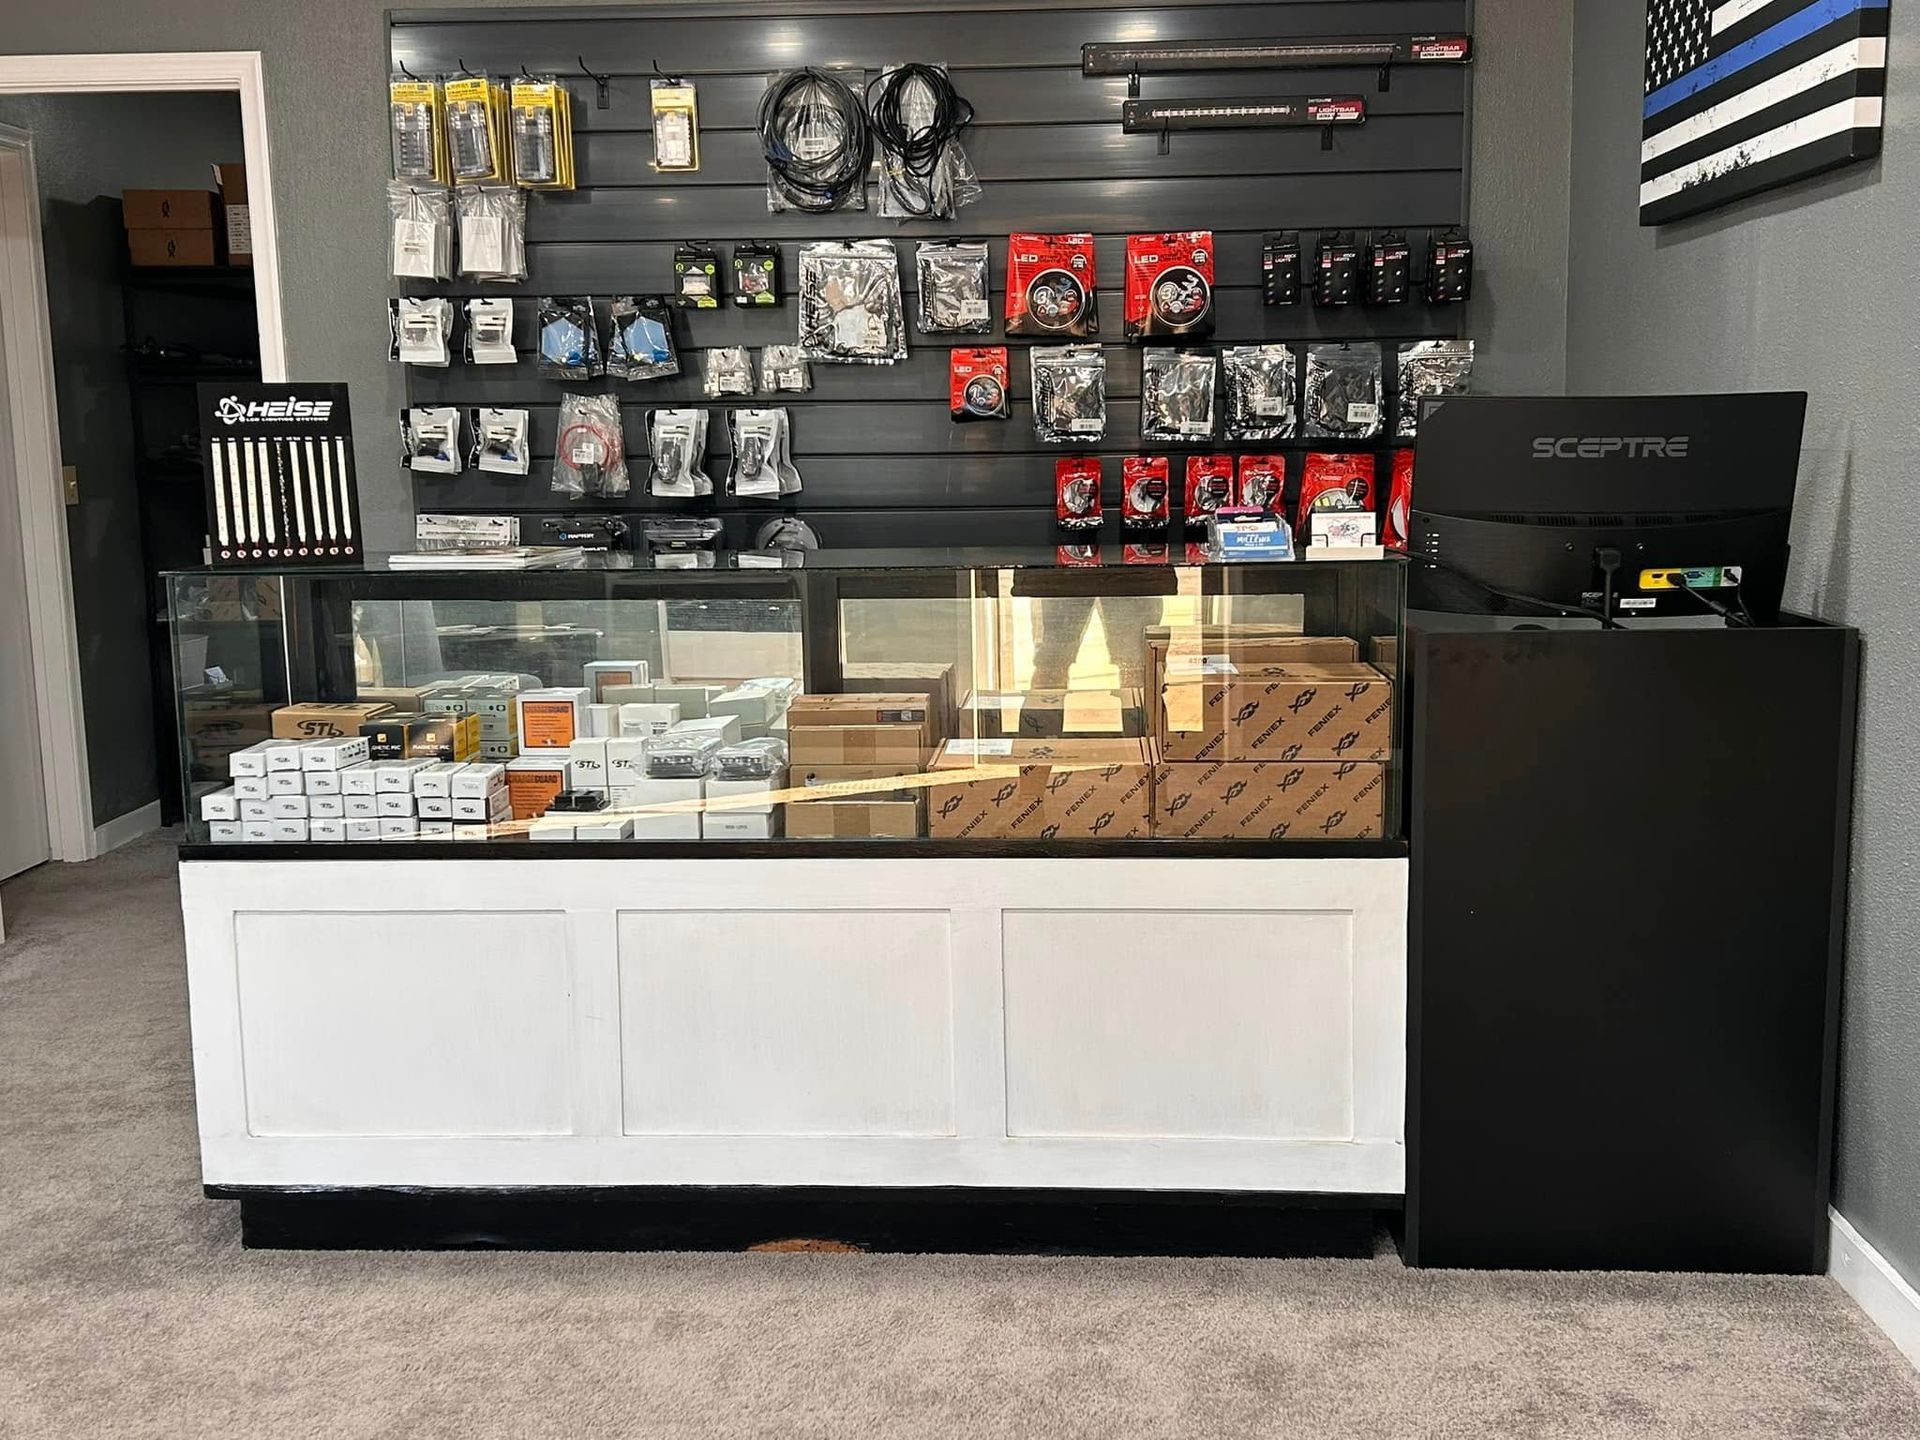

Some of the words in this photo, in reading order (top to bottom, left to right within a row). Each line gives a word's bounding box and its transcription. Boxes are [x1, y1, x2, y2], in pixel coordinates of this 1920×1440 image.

[1013, 254, 1038, 262] LED
[1134, 254, 1158, 263] LED
[246, 397, 333, 417] HEISE
[1532, 435, 1689, 459] SCEPTRE
[301, 721, 340, 737] STL
[1251, 717, 1286, 749] FENIEX
[1308, 705, 1342, 737] FENIEX
[1195, 729, 1228, 760] FENIEX
[576, 760, 599, 769] STL
[1010, 797, 1043, 829] FENIEX
[1065, 785, 1097, 817] FENIEX
[1239, 795, 1274, 827] FENIEX
[1296, 783, 1330, 815] FENIEX
[1184, 808, 1217, 838] FENIEX
